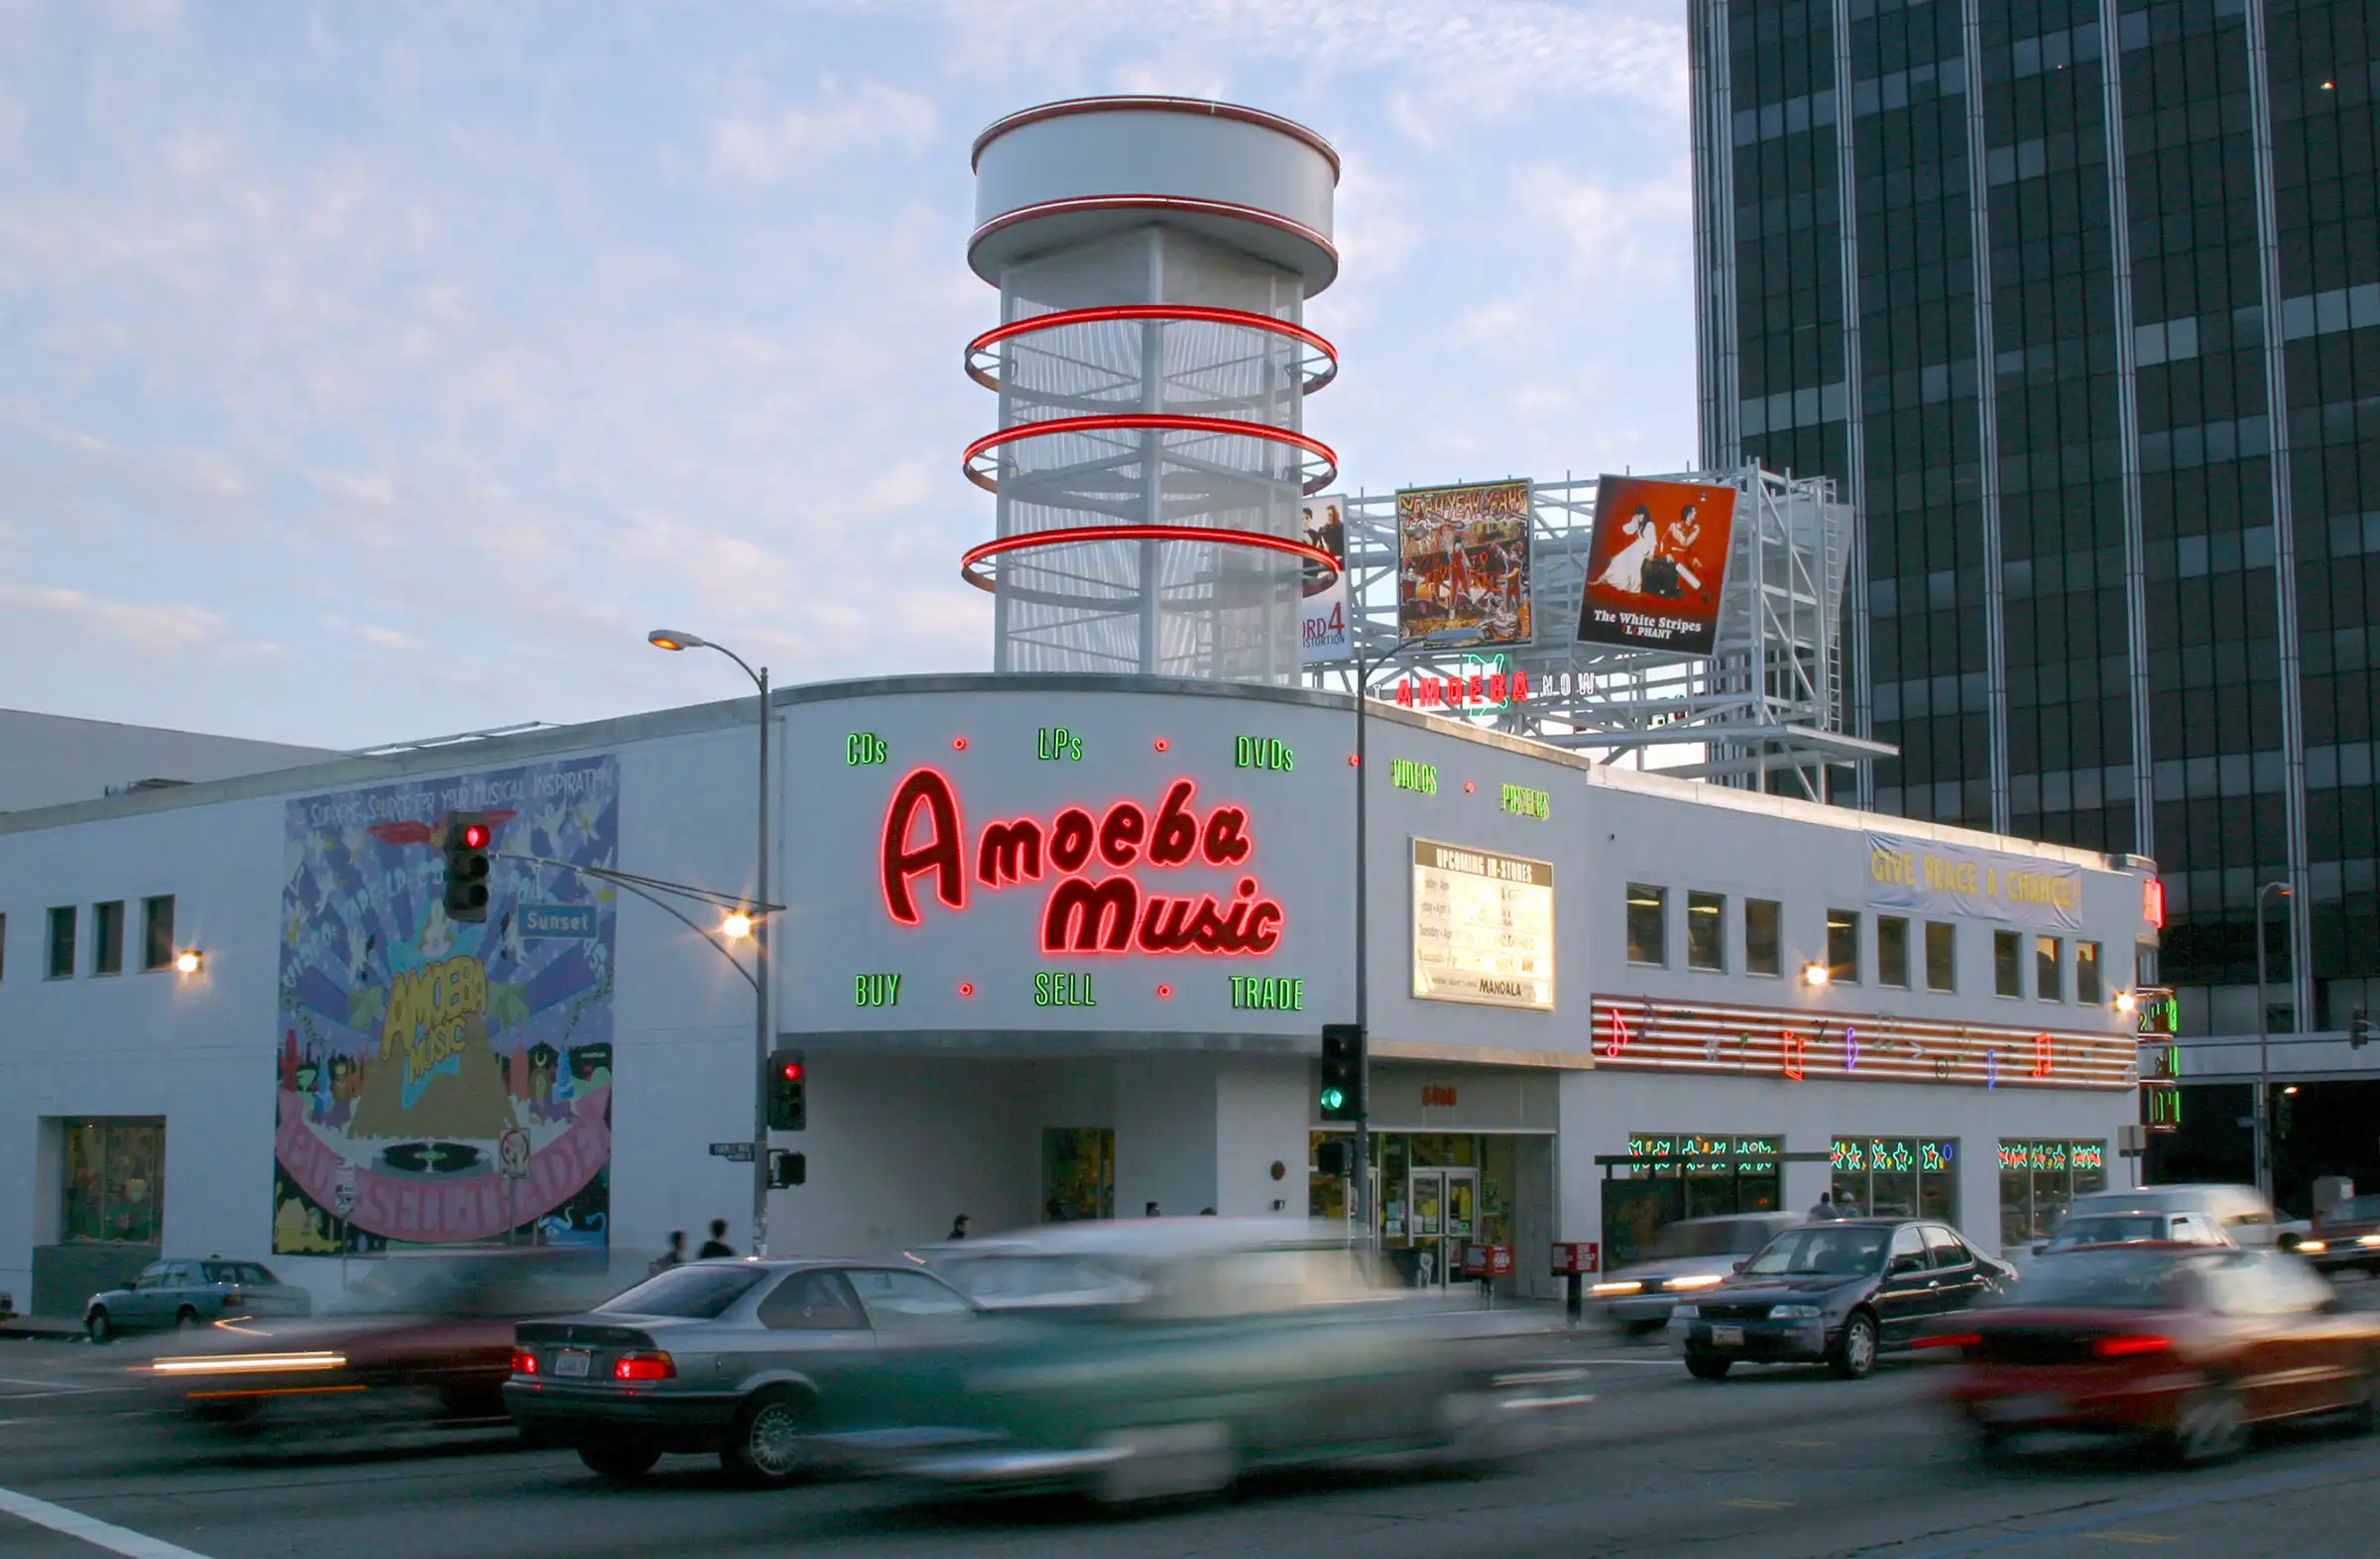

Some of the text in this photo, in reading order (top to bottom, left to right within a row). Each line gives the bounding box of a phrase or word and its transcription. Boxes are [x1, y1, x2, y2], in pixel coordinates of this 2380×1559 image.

[1595, 609, 1702, 634] The White Stripes
[1396, 670, 1530, 708] AMOEBA
[1542, 672, 1596, 696] NOW
[846, 732, 888, 766] CDs
[1037, 727, 1083, 762] LPs
[1235, 735, 1294, 772] DVDs
[1390, 759, 1437, 796] VIDEOS
[473, 778, 526, 806] MUSICAL
[881, 768, 1252, 925] Amoeba
[1436, 848, 1532, 884] UPCOMING IN-STORES
[1871, 848, 2080, 908] GIVE PEACE A CHANCE!
[527, 910, 589, 931] Sunset
[1041, 875, 1284, 955] Music
[380, 955, 488, 1061] AMOEBA
[855, 972, 1304, 1012] BUY SELL TRADE
[408, 1017, 468, 1085] MUSIC
